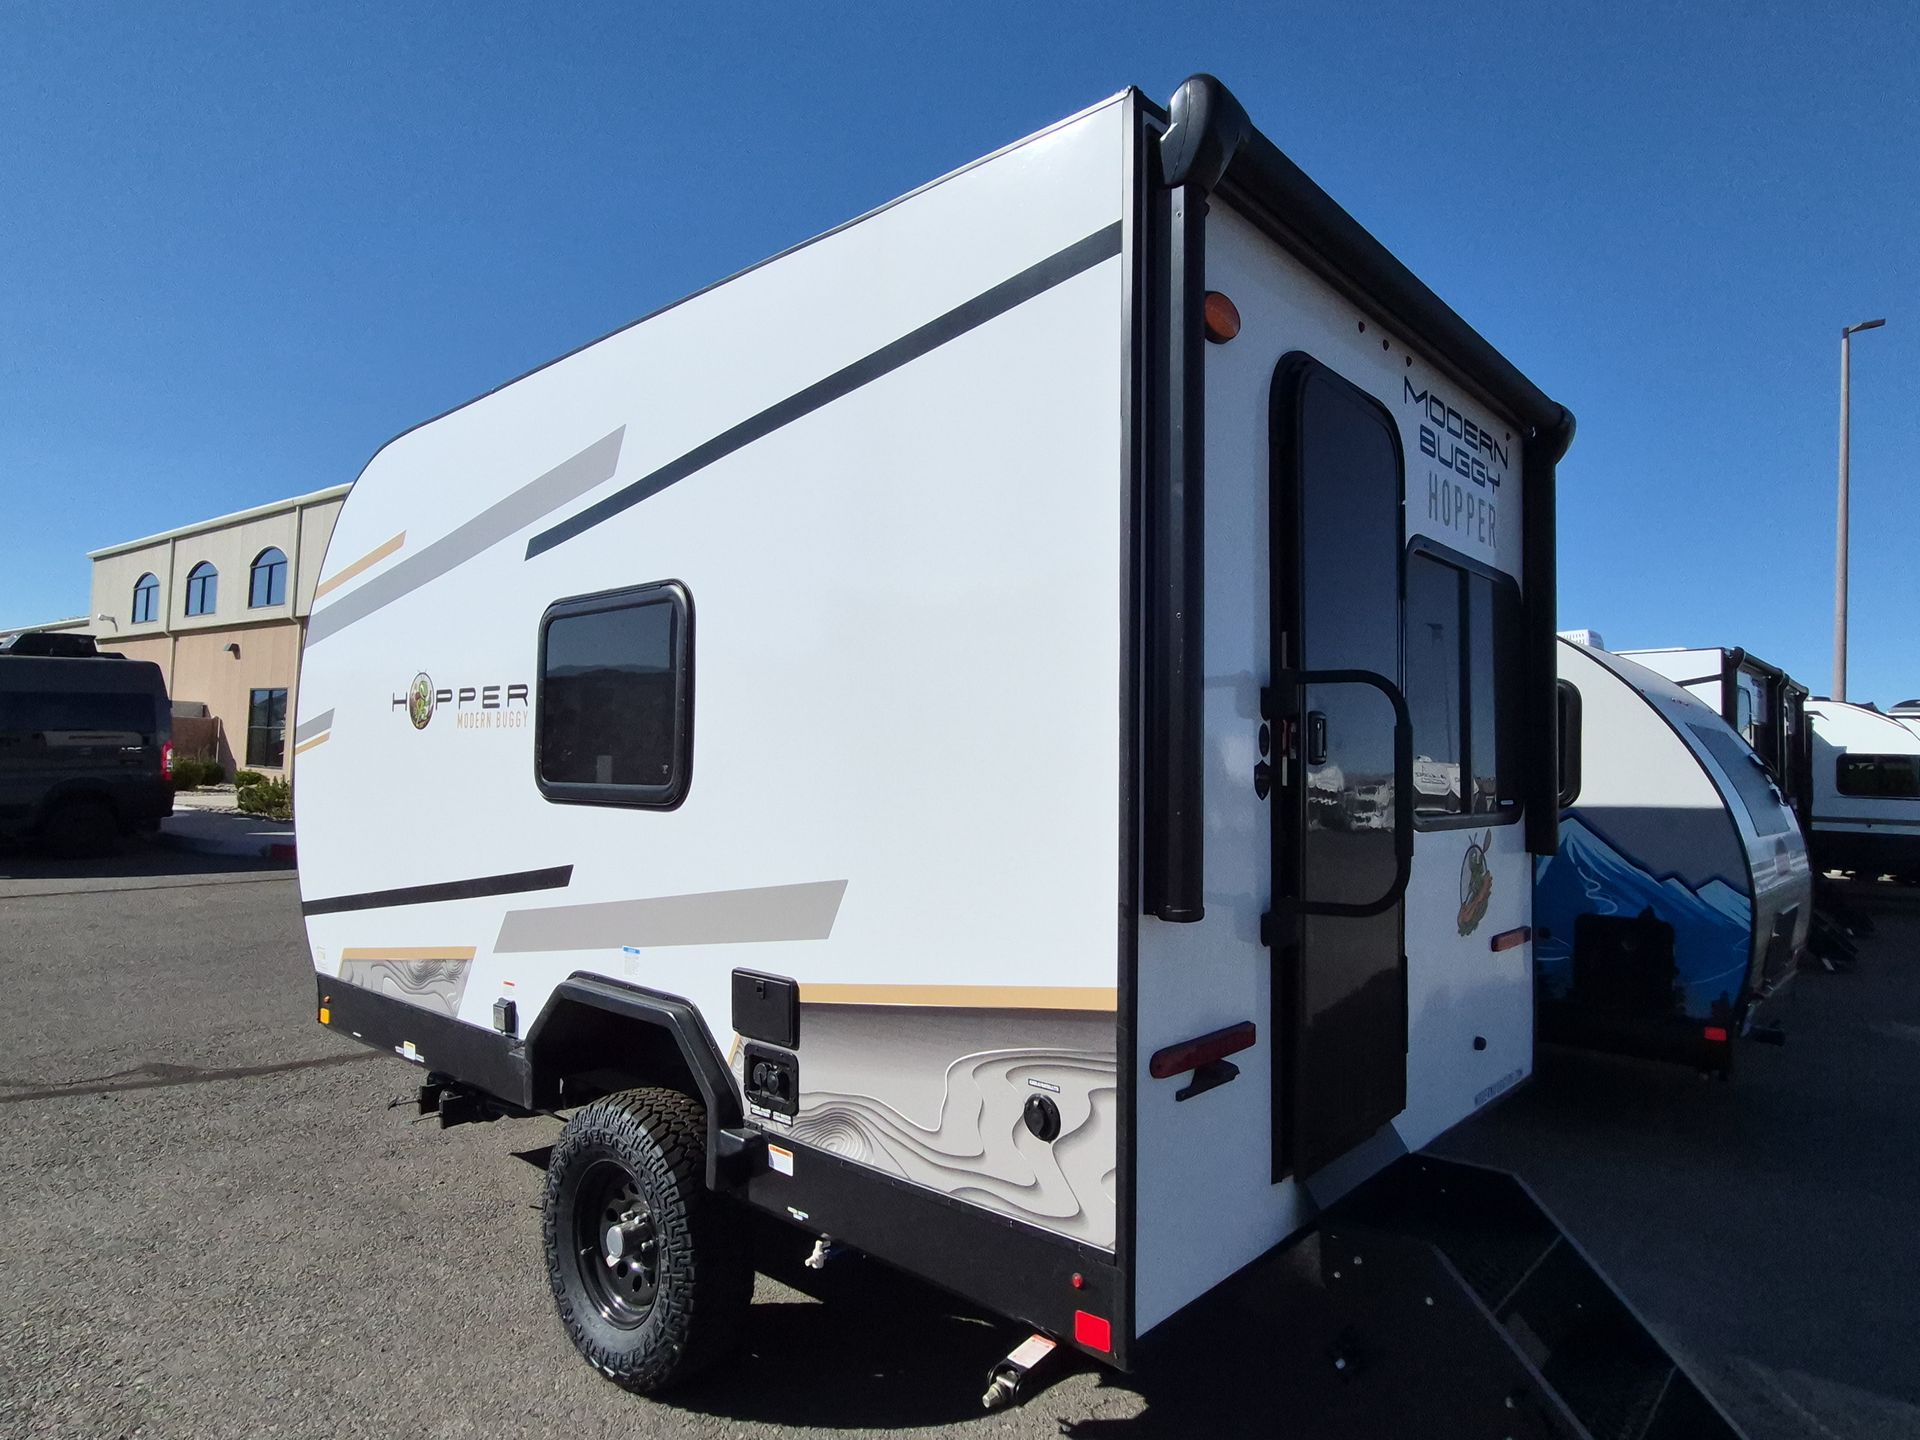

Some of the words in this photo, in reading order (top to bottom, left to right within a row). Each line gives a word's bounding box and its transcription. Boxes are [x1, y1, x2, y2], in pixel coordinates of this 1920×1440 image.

[1403, 375, 1509, 470] MODERN
[1419, 423, 1501, 494] BUGGY
[1428, 469, 1497, 549] HOPPER
[456, 712, 492, 729] MODERN
[496, 710, 529, 728] BUGGY
